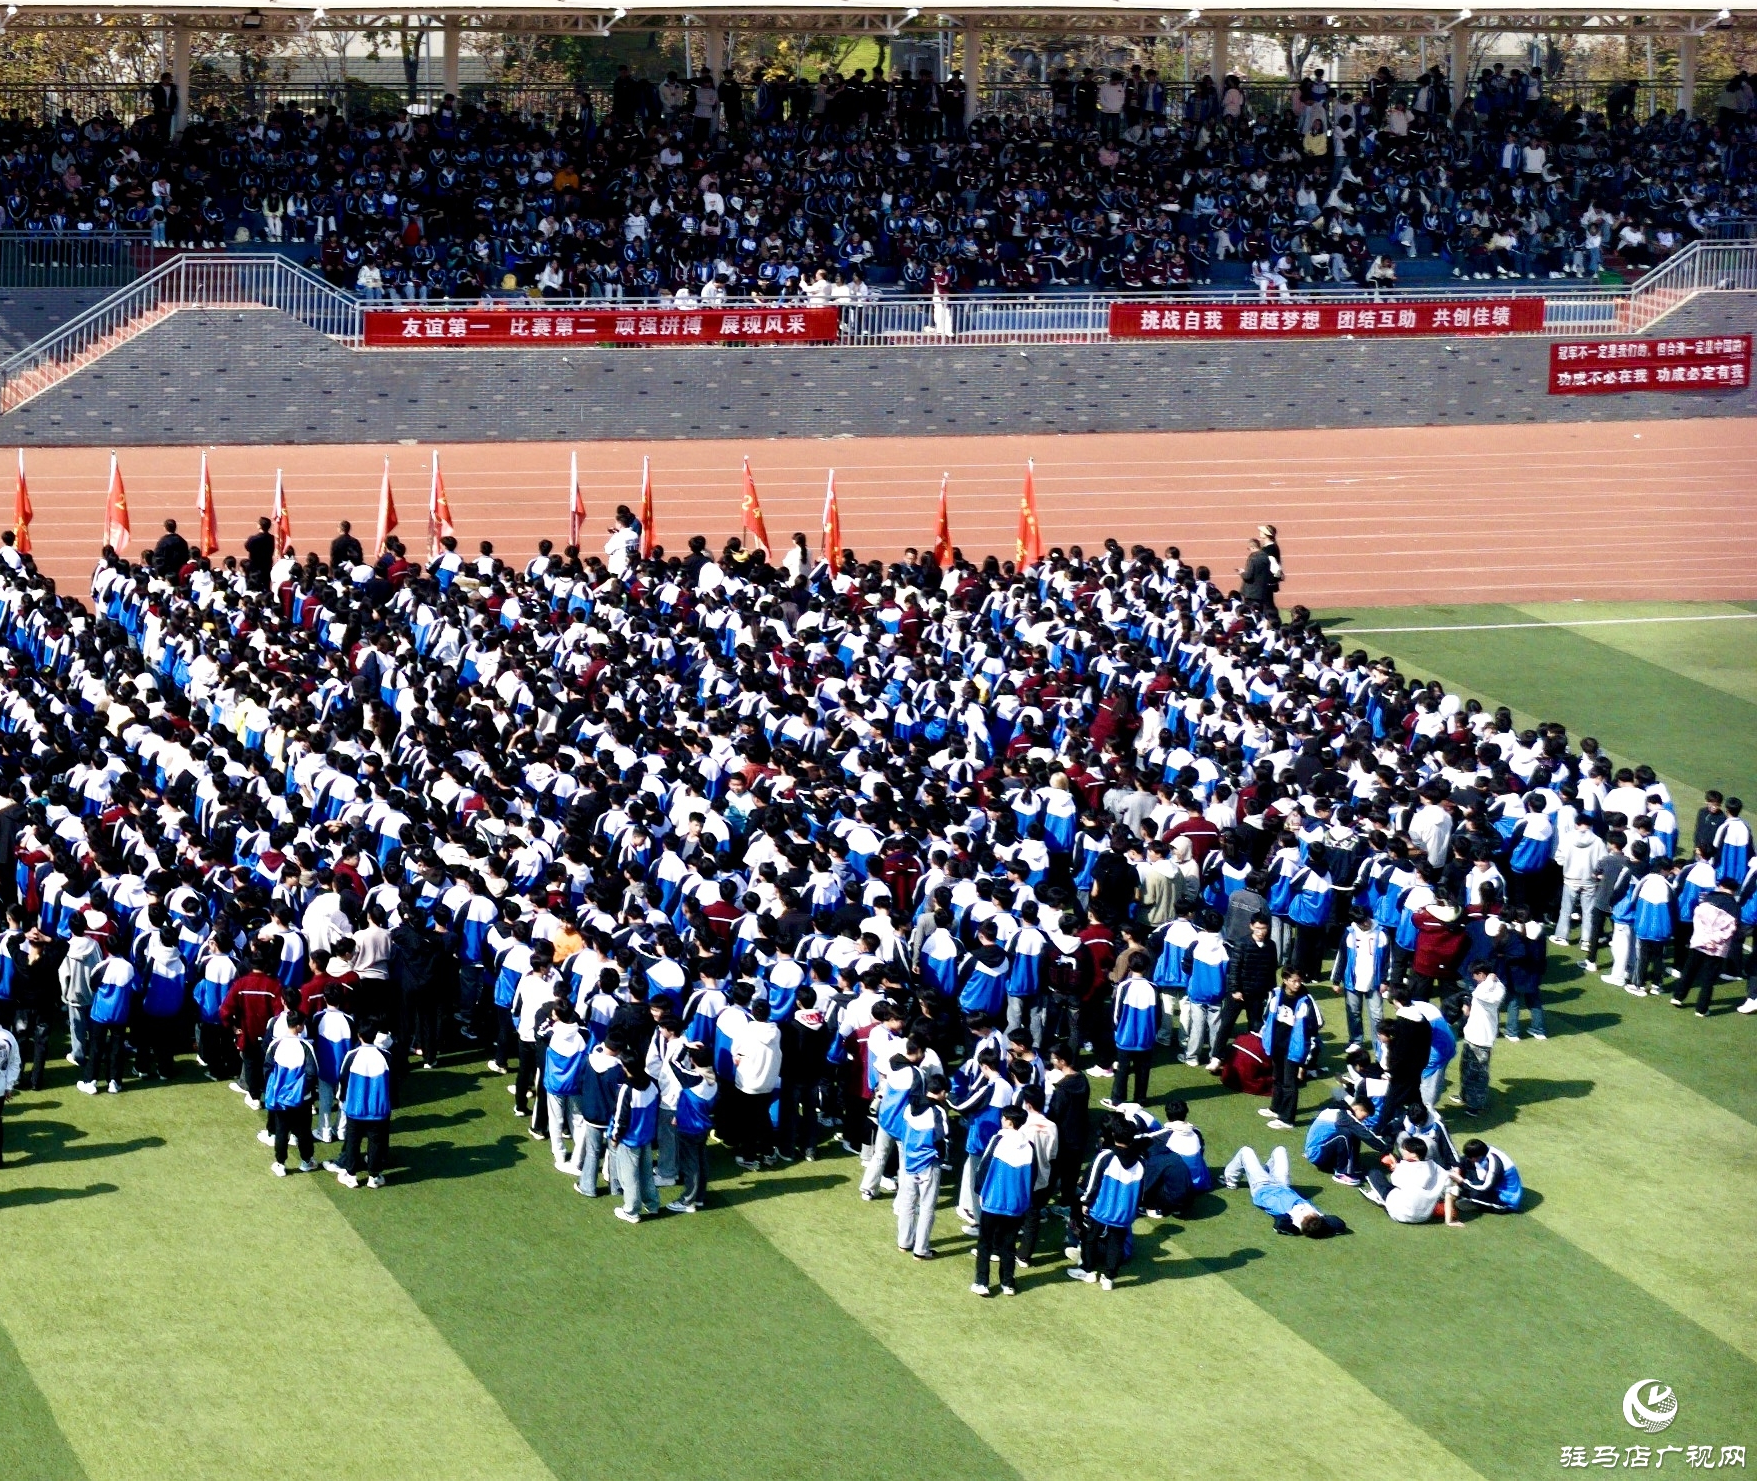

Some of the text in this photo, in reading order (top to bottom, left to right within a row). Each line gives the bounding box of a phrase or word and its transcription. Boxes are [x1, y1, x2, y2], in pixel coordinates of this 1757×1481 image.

[401, 313, 807, 339] 友谊第一 比赛第二 顽强拼搏 展现风采
[1140, 306, 1511, 331] 挑战自我 超越梦想 团结互助 共创佳绩
[1655, 364, 1745, 385] 功成必定有我
